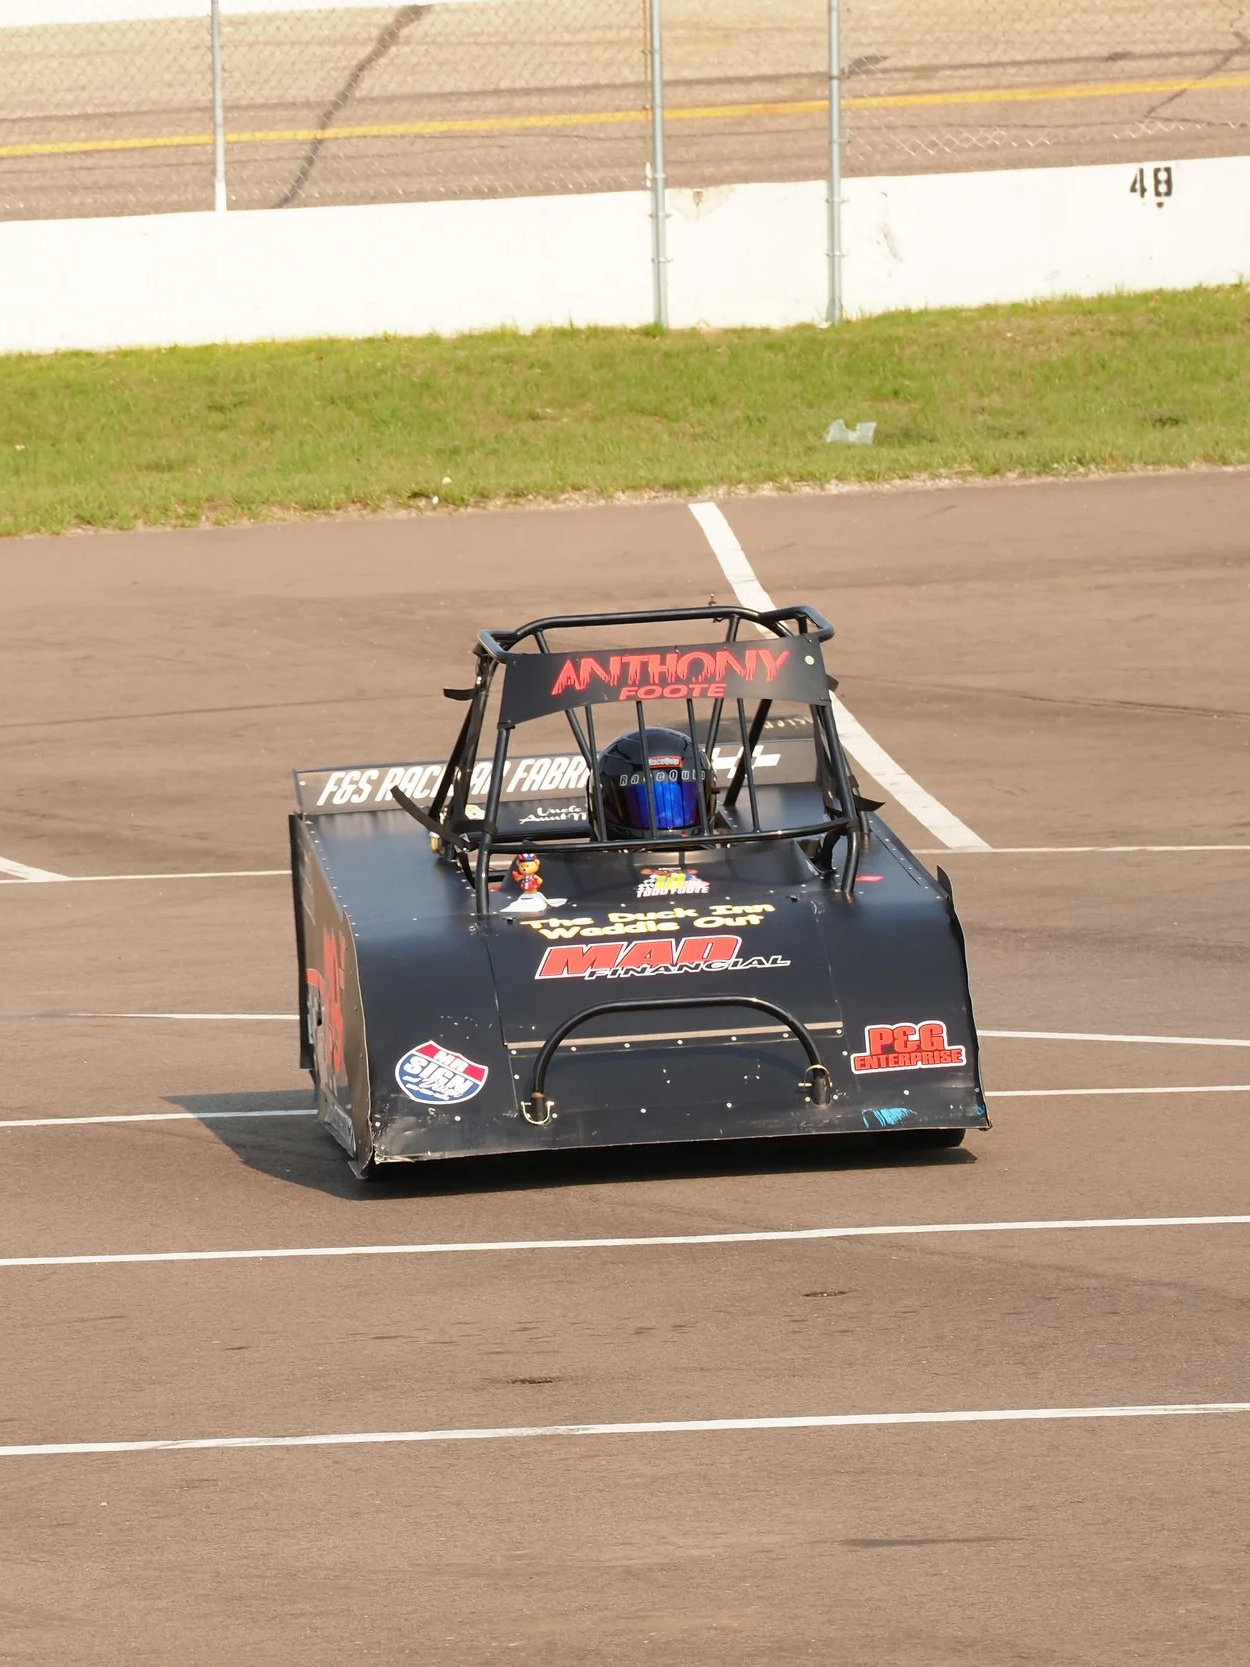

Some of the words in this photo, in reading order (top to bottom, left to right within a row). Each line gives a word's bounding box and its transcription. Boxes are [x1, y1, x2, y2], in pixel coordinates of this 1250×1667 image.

[1129, 167, 1172, 198] 48
[551, 649, 790, 695] ANTHONY
[619, 684, 727, 700] FOOTE
[316, 770, 379, 806] F&S
[519, 915, 594, 929] The
[608, 907, 698, 922] Duck
[709, 904, 776, 914] Inn
[538, 919, 680, 940] Waddle
[693, 914, 765, 929] Out
[534, 935, 742, 980] MAD
[584, 955, 791, 980] FINANCIAL
[868, 1023, 945, 1055] P&G
[432, 1050, 469, 1073] MR
[854, 1049, 963, 1071] ENTERPRISE
[403, 1055, 474, 1096] SIGN
